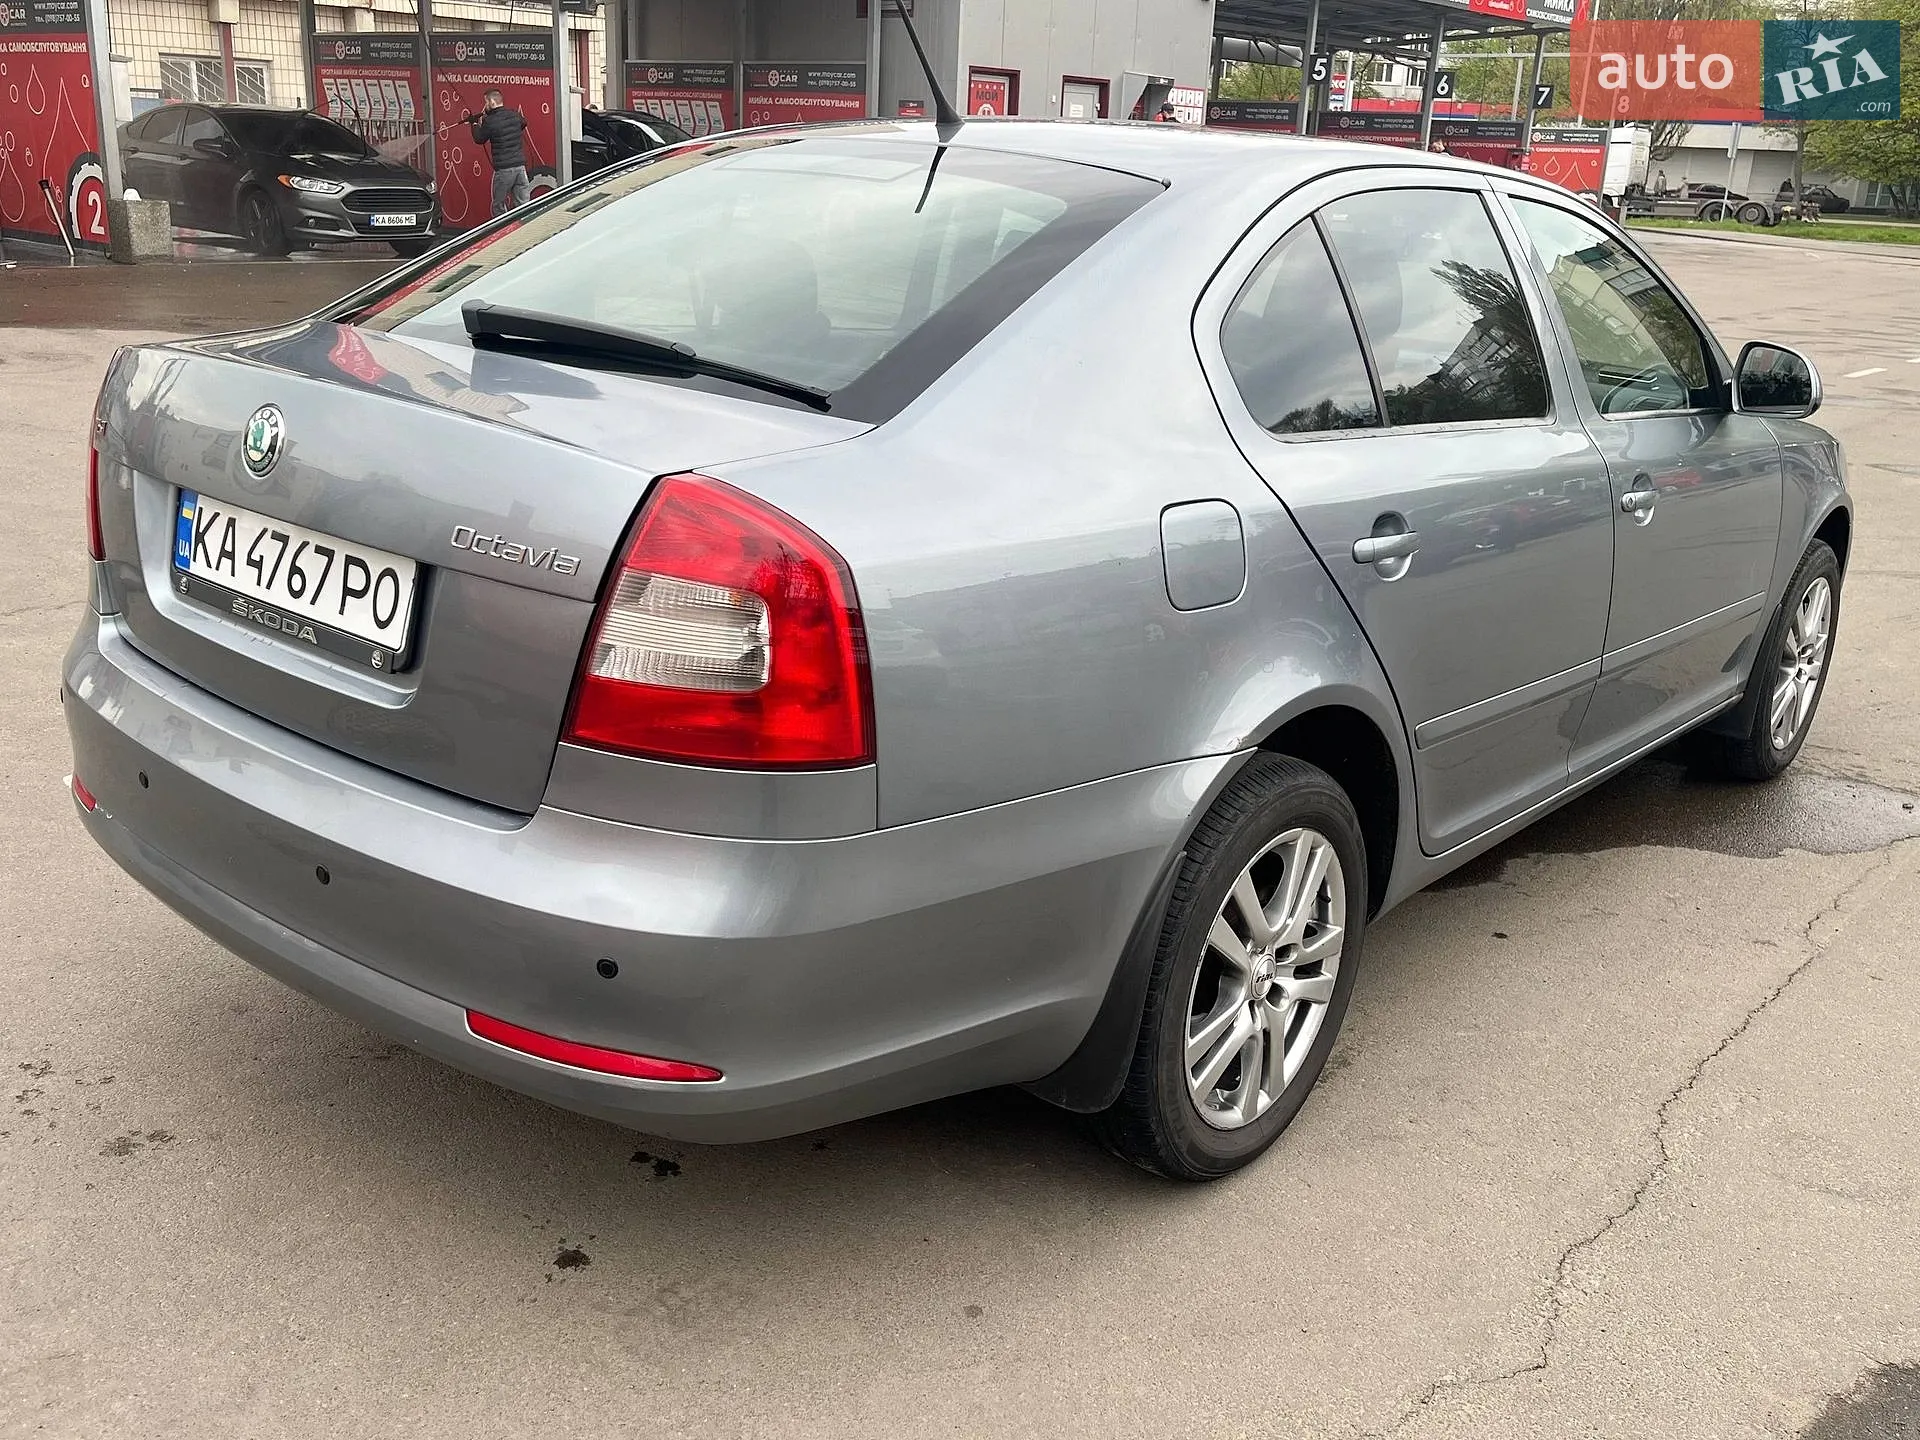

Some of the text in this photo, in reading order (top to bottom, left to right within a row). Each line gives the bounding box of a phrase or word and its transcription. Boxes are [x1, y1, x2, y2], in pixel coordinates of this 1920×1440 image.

[9, 8, 26, 20] CAR
[8, 42, 88, 53] САМООБСЛУГОВУВАННЯ
[345, 46, 361, 55] CAR
[467, 47, 486, 56] CAR
[495, 43, 544, 51] www.moycar.com
[658, 71, 674, 80] CAR
[1311, 58, 1327, 81] 5
[463, 74, 550, 86] САМООБСЛУГОВУВАННЯ
[779, 74, 798, 83] CAR
[1436, 74, 1450, 96] 6
[774, 96, 860, 109] САМООБСЛУГОВУВАННЯ
[1537, 86, 1551, 106] 7
[1617, 95, 1630, 114] 8
[88, 190, 105, 235] 2
[376, 216, 415, 224] KA 8606 ME
[178, 540, 191, 558] UA
[450, 525, 582, 576] Octavia
[192, 506, 400, 630] KA 4767 PO
[232, 597, 318, 645] ŠKODA
